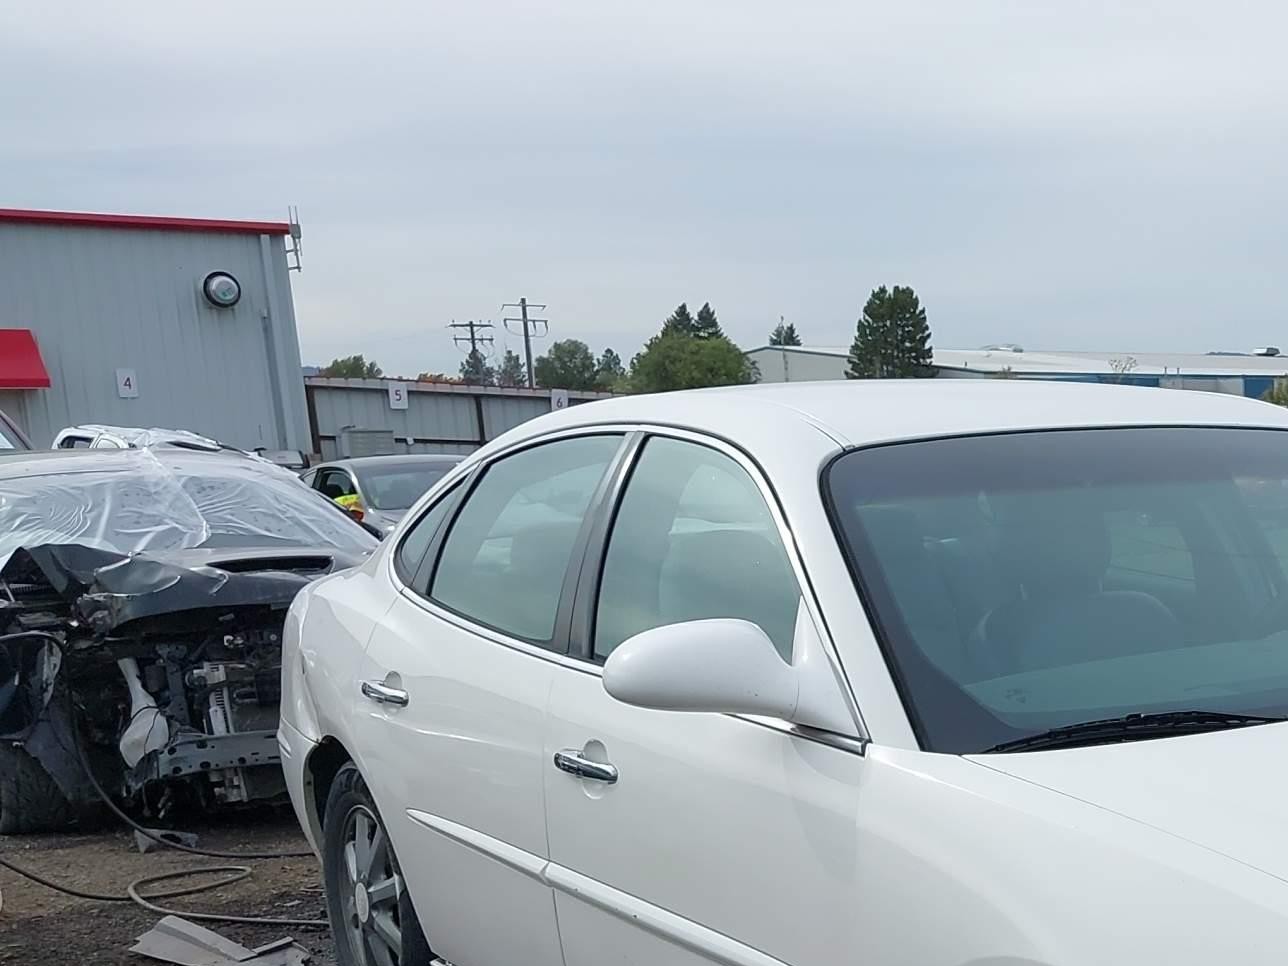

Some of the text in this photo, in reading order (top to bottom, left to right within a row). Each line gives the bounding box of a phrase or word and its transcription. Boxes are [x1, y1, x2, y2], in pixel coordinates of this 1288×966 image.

[122, 376, 133, 390] 4
[394, 389, 402, 402] 5
[556, 396, 564, 409] 6
